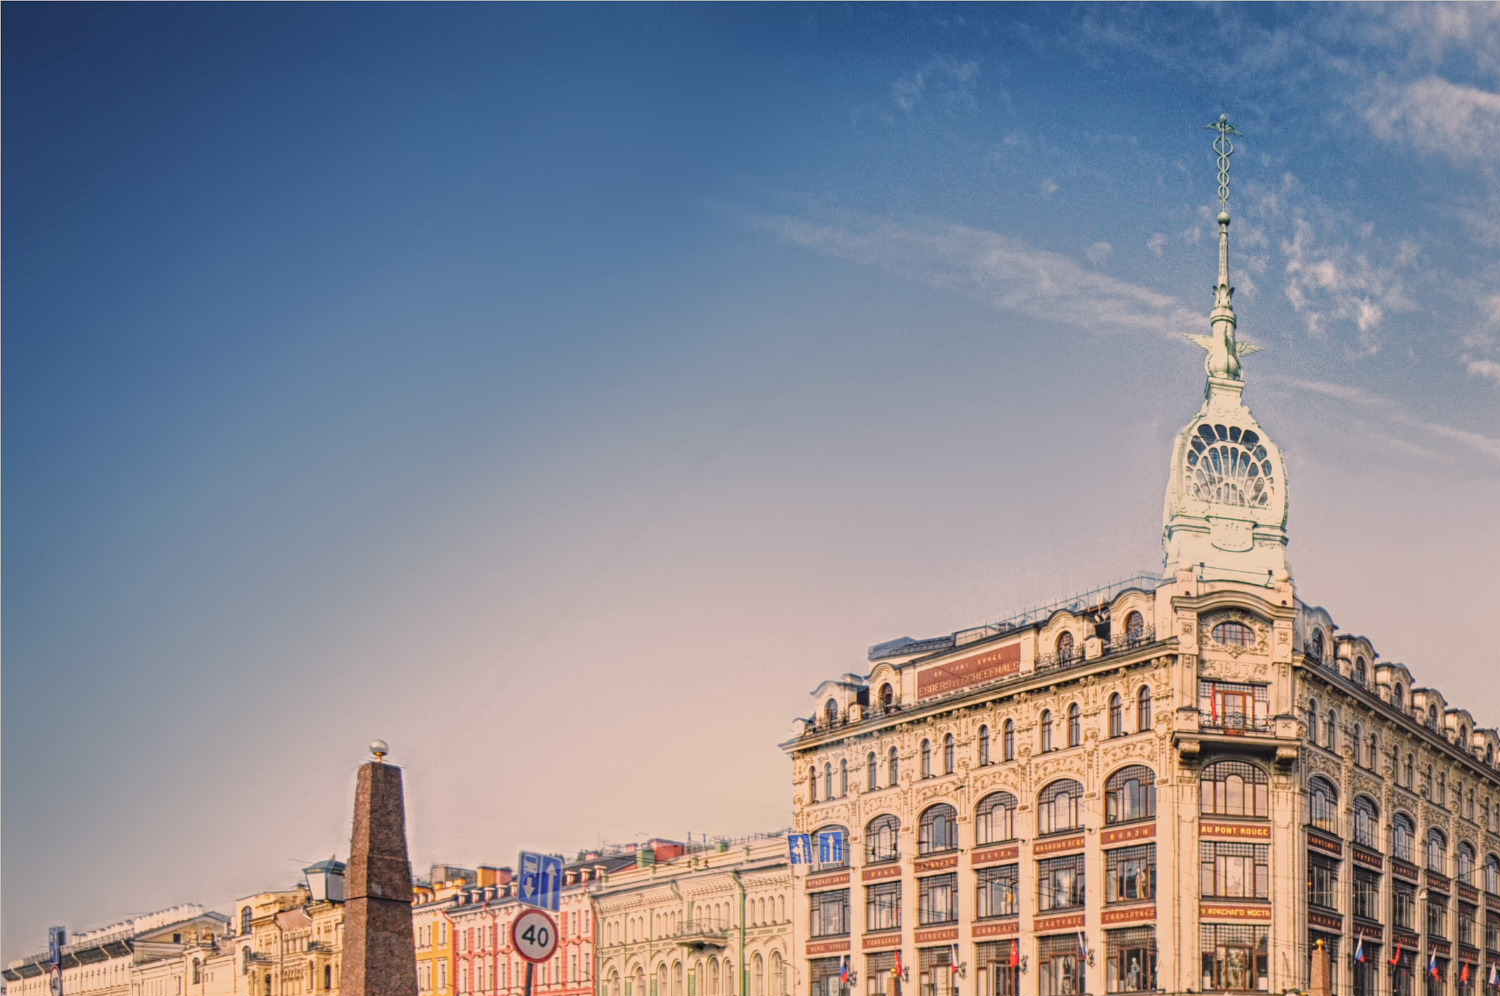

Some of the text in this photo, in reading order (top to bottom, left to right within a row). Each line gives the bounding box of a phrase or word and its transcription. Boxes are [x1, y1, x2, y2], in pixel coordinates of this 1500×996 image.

[919, 680, 951, 697] ESDERS
[1201, 826, 1269, 836] AU PONT ROUGE
[1208, 908, 1244, 916] КРАСНАГО
[1247, 909, 1270, 917] МОСТА
[521, 924, 549, 948] 40
